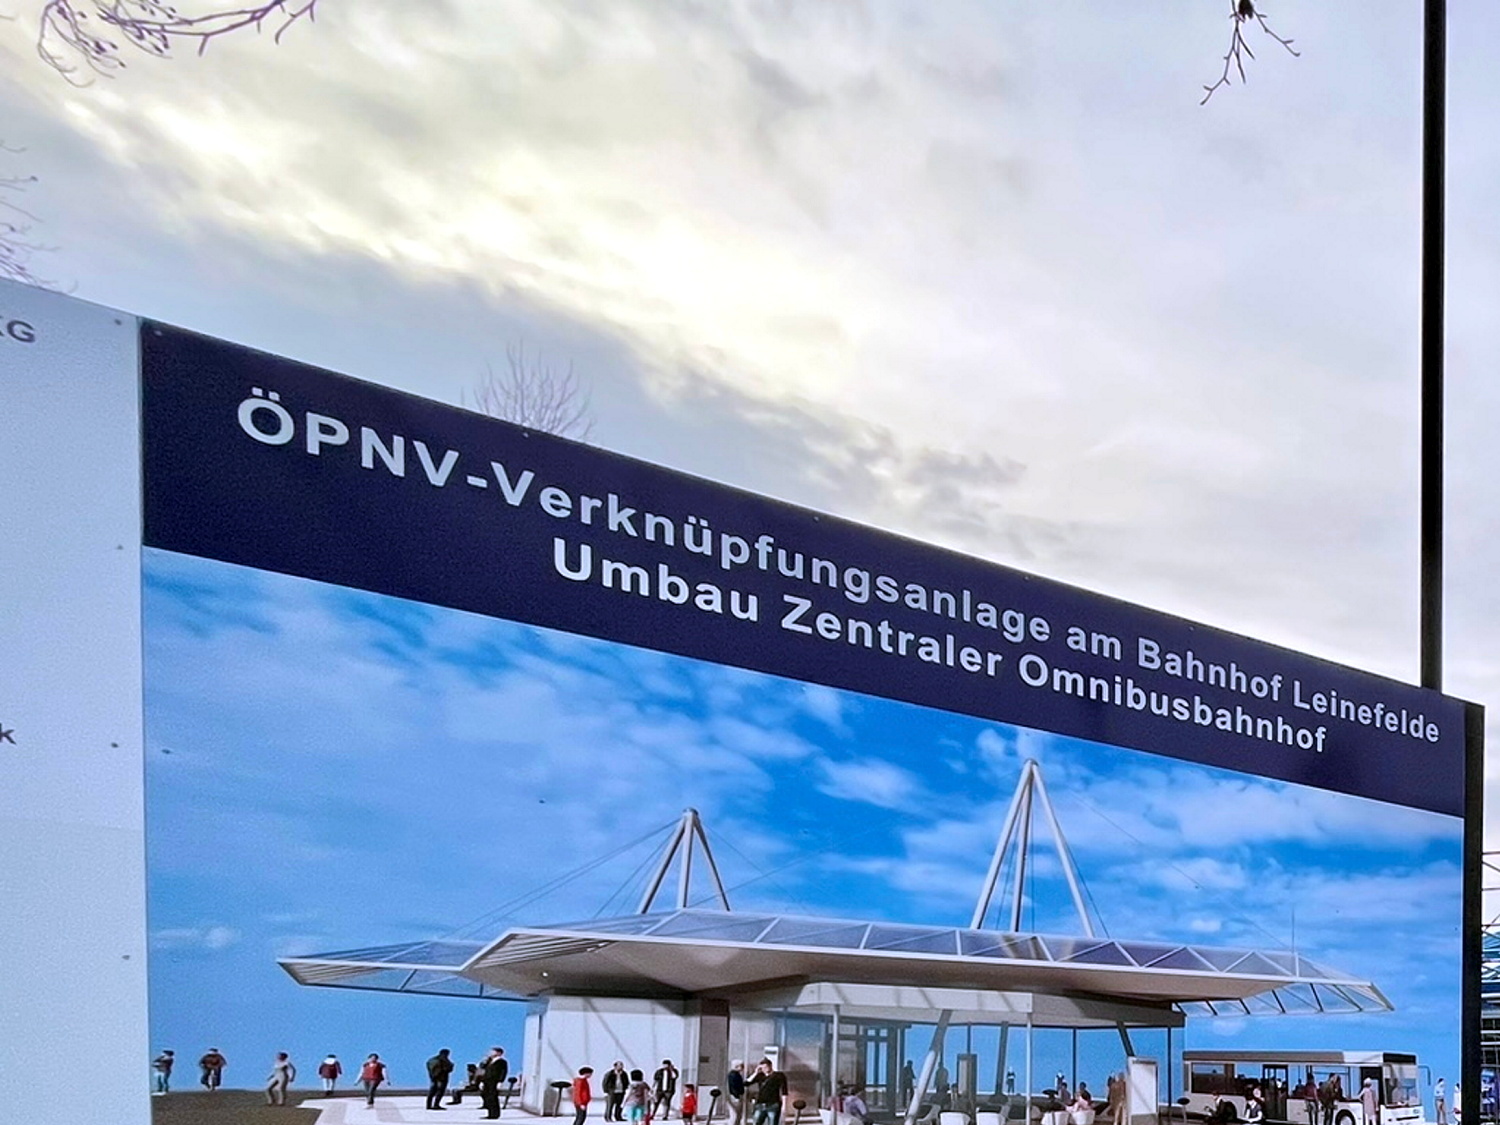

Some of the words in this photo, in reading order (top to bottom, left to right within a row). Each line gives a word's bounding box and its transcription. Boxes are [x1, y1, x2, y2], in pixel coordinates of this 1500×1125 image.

[237, 387, 1050, 643] ÖPNV-Verknüpfungsanlage
[1066, 626, 1121, 661] am
[1138, 637, 1283, 701] Bahnhof
[1293, 680, 1439, 743] Leinefelde
[554, 537, 758, 622] Umbau
[781, 594, 1003, 676] Zentraler
[1019, 654, 1327, 753] Omnibusbahnhof
